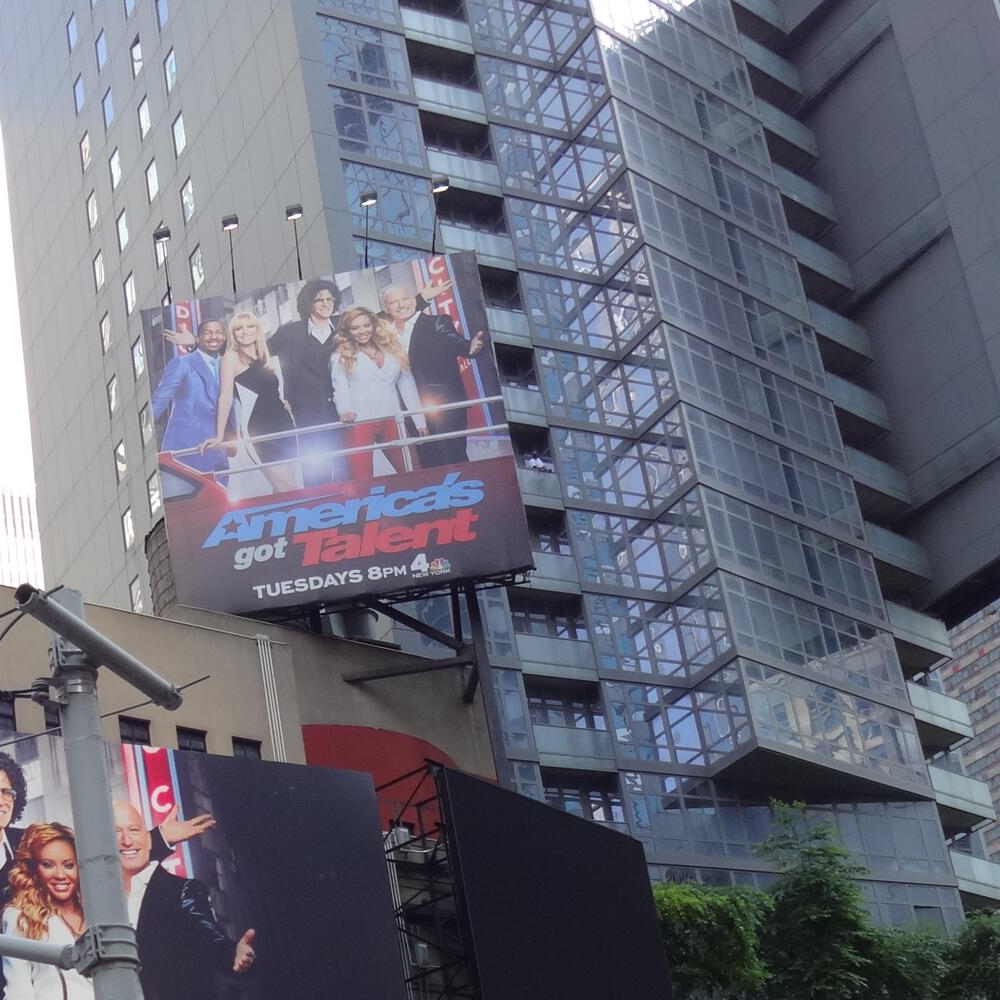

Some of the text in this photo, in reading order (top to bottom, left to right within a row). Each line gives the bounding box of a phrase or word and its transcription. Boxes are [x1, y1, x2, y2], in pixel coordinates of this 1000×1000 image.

[202, 472, 485, 549] America's
[233, 509, 479, 571] got Talent
[253, 569, 363, 599] TUESDAYS
[367, 565, 408, 581] 8PM
